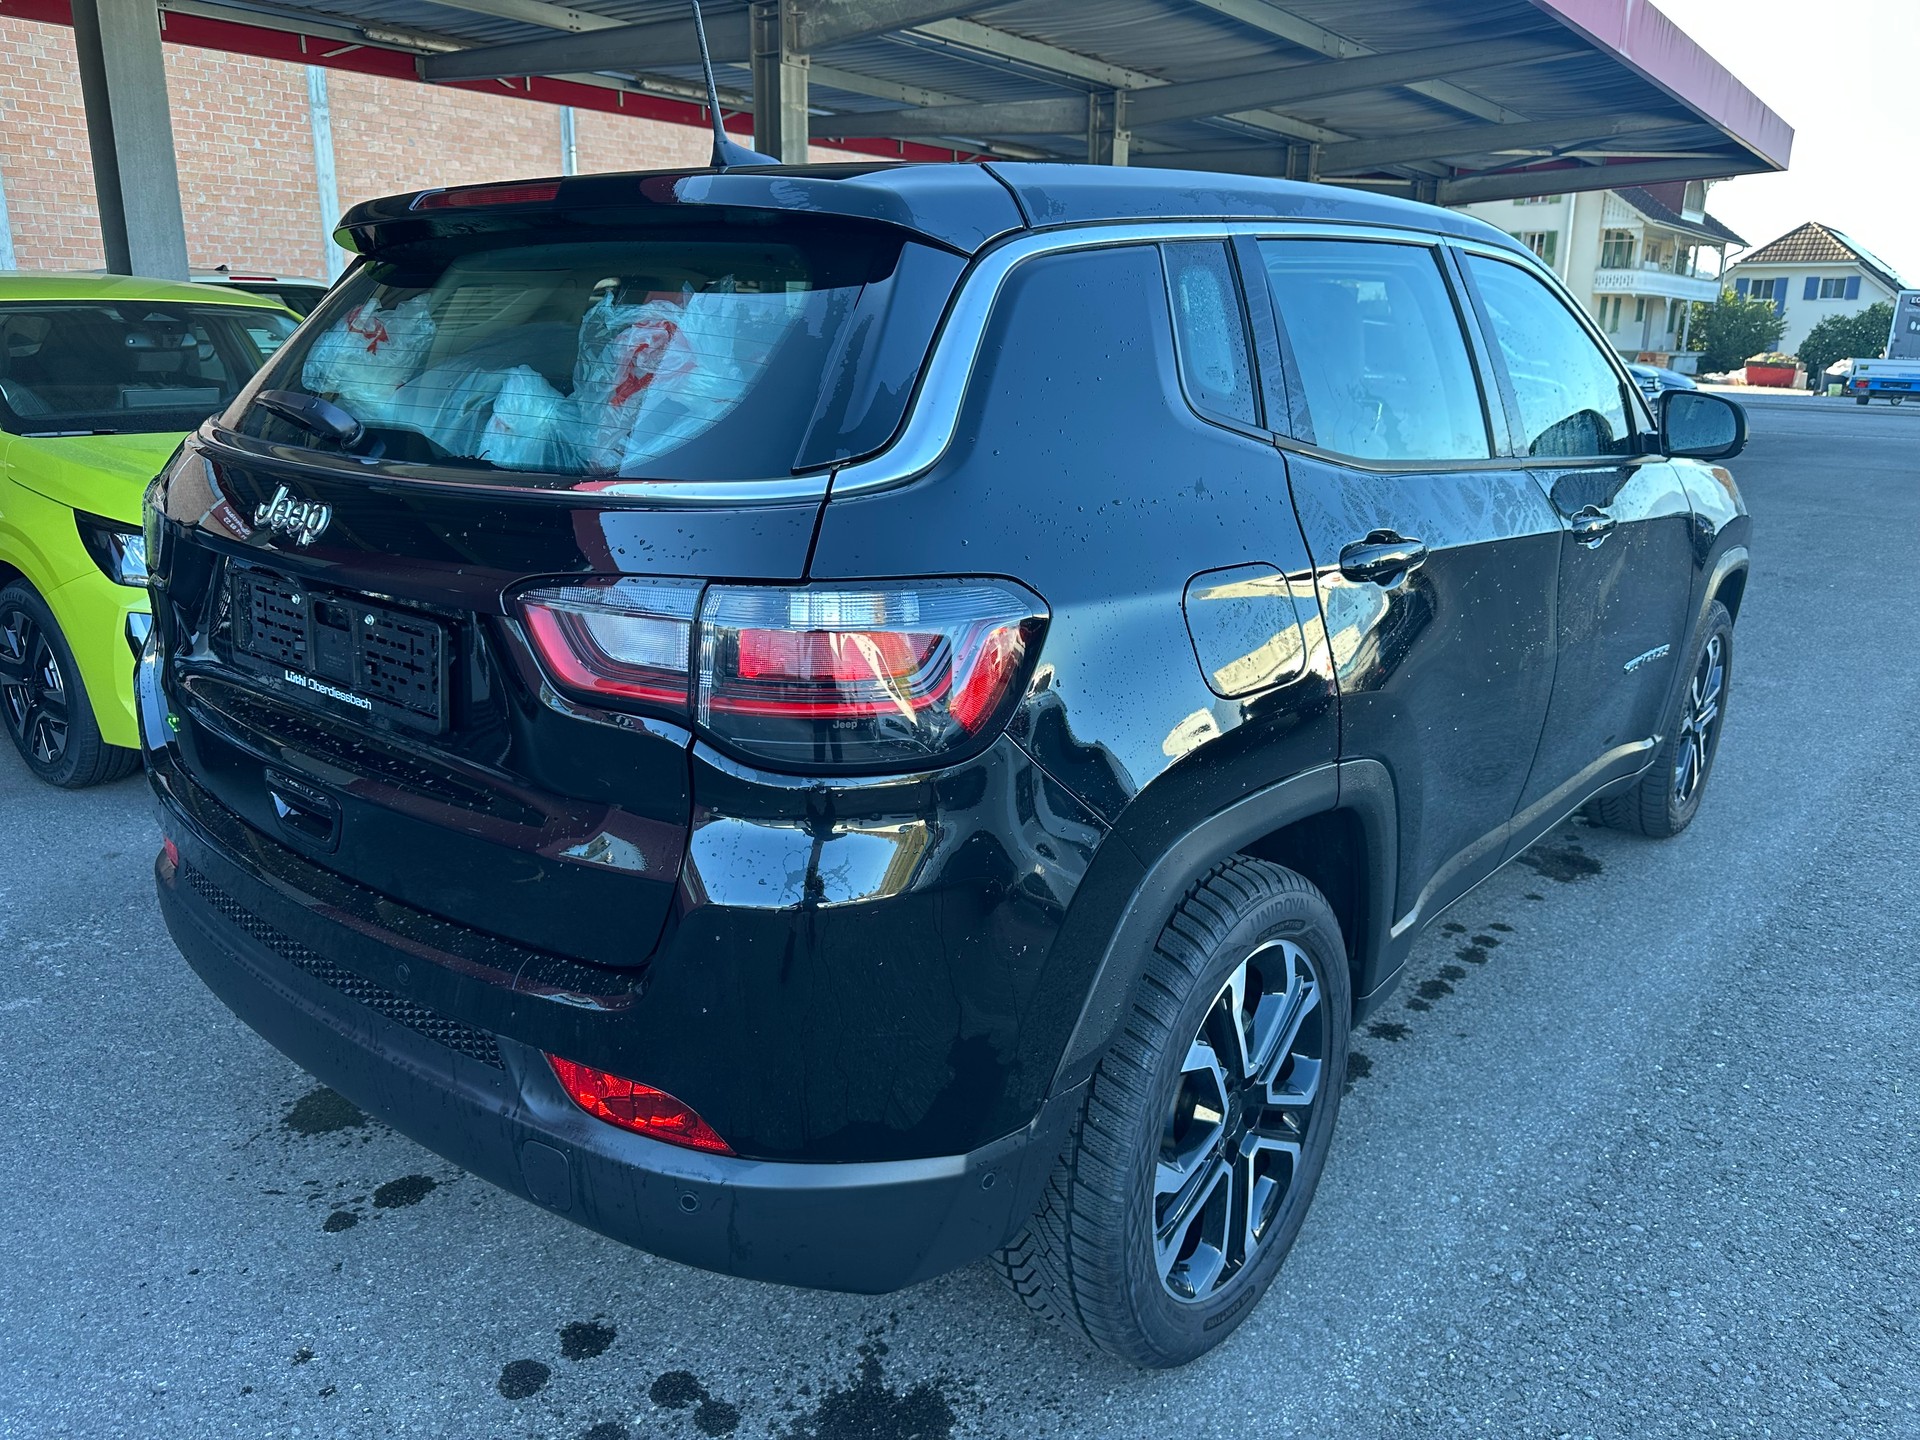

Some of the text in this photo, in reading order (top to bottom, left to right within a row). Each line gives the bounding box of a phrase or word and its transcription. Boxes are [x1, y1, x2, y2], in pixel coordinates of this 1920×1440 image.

[254, 482, 332, 548] Jeep
[285, 669, 372, 711] Lüthi Oberdiessbach
[833, 720, 858, 730] Jeep
[1250, 897, 1311, 931] UNIROYAL
